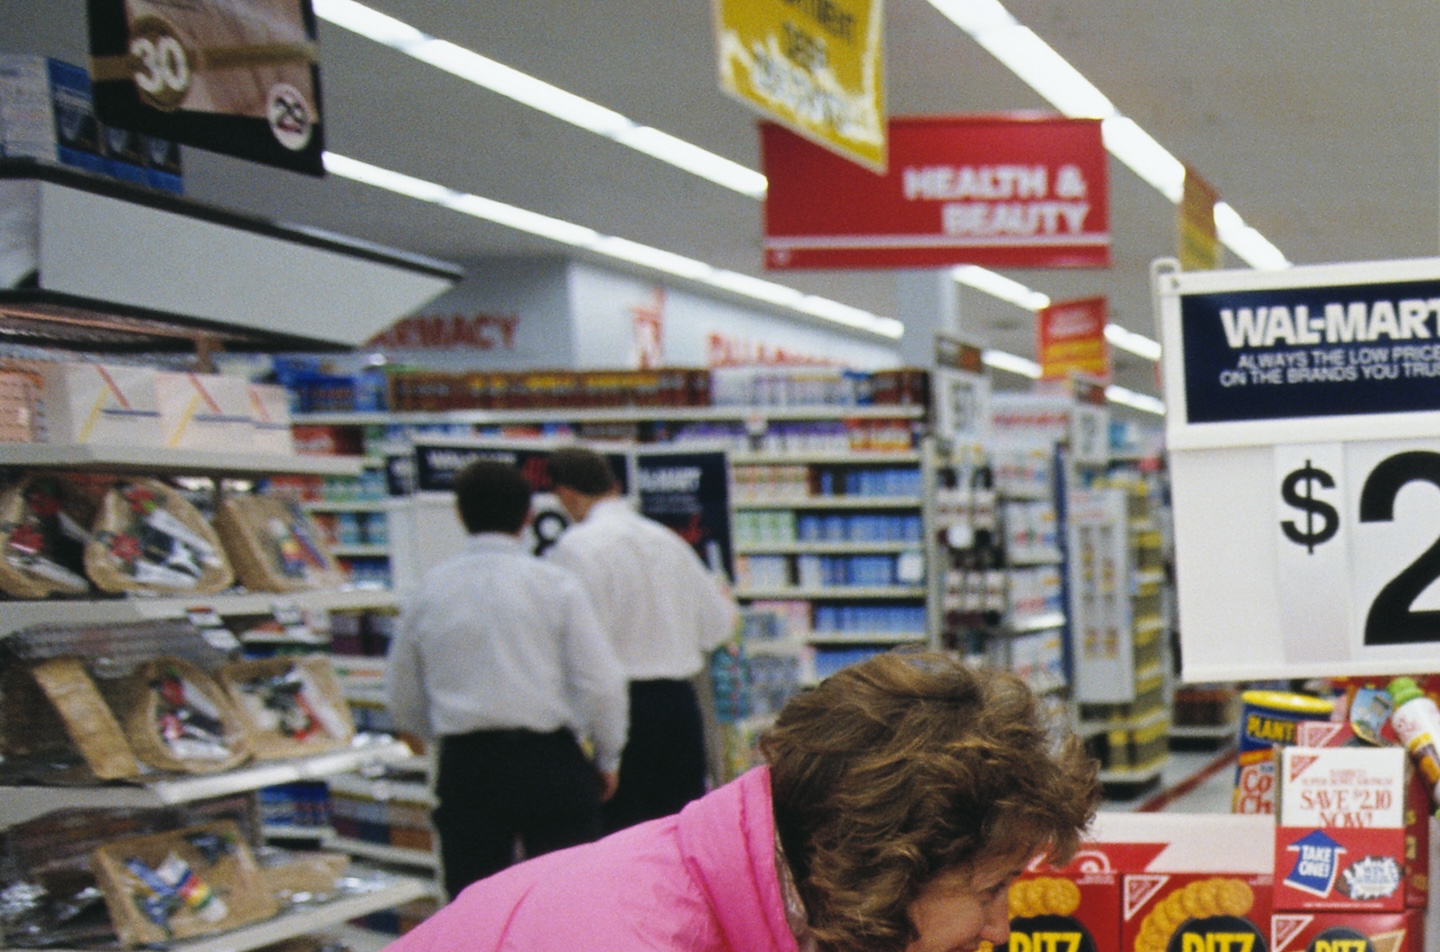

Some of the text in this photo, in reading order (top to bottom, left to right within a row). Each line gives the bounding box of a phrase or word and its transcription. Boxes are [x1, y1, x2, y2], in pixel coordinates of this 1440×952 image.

[129, 34, 190, 94] 30
[902, 163, 1088, 200] HEALTH &
[942, 201, 1091, 236] BEAUTY
[1237, 350, 1309, 369] ALWAYS
[1311, 349, 1345, 367] THE
[1349, 346, 1388, 365] LOW
[1219, 369, 1248, 387] ON
[1250, 367, 1284, 386] THE
[1286, 362, 1358, 384] BRANDS
[1361, 361, 1399, 380] YOU
[1300, 789, 1350, 810] SAVE
[1301, 843, 1333, 860] TAKE
